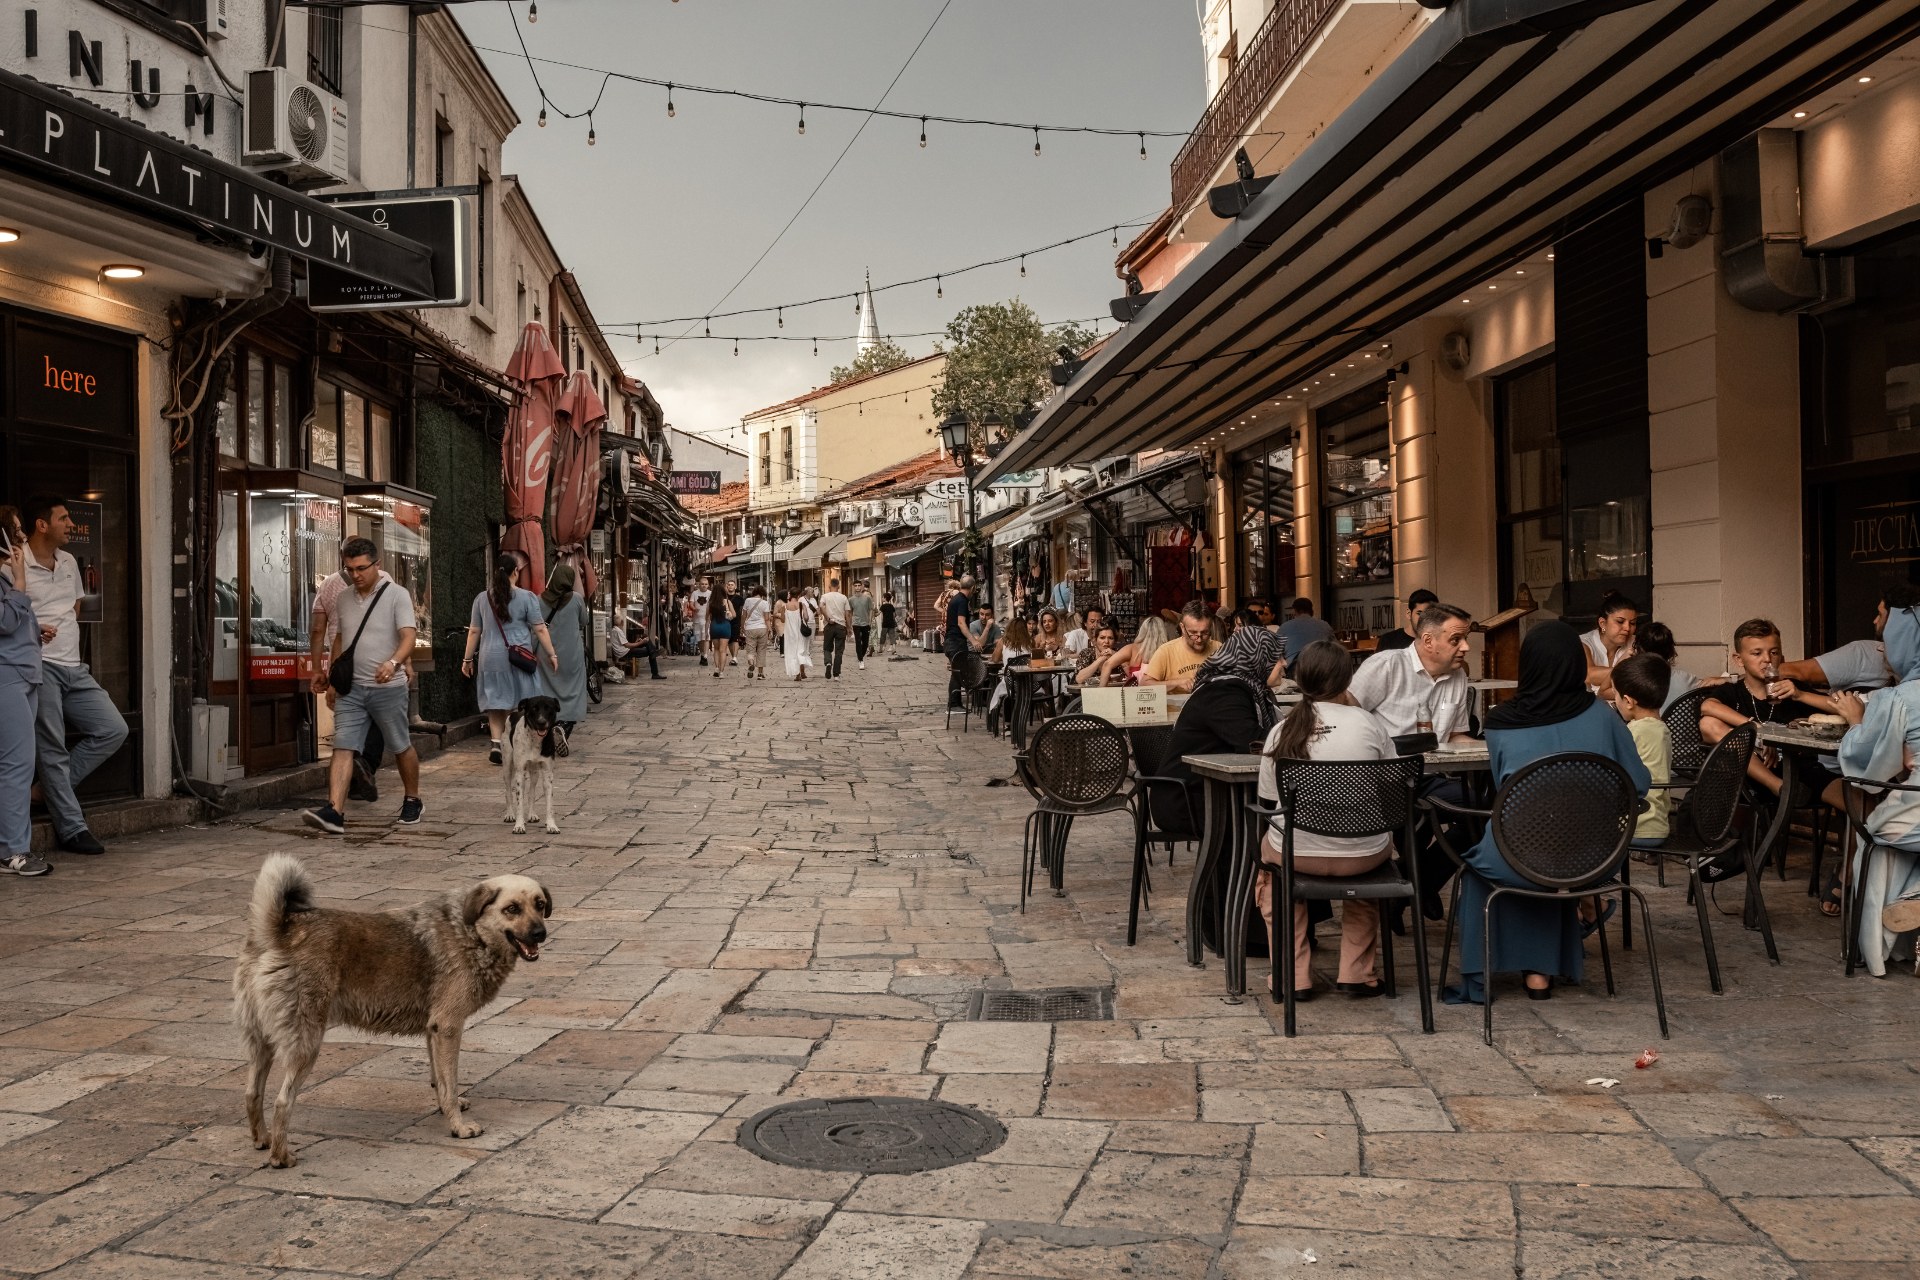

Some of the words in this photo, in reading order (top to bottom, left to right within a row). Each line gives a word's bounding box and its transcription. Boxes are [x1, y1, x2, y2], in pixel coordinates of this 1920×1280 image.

[44, 110, 351, 263] PLATINUM
[44, 355, 96, 396] here
[689, 476, 710, 489] GOLD
[938, 481, 969, 494] tet
